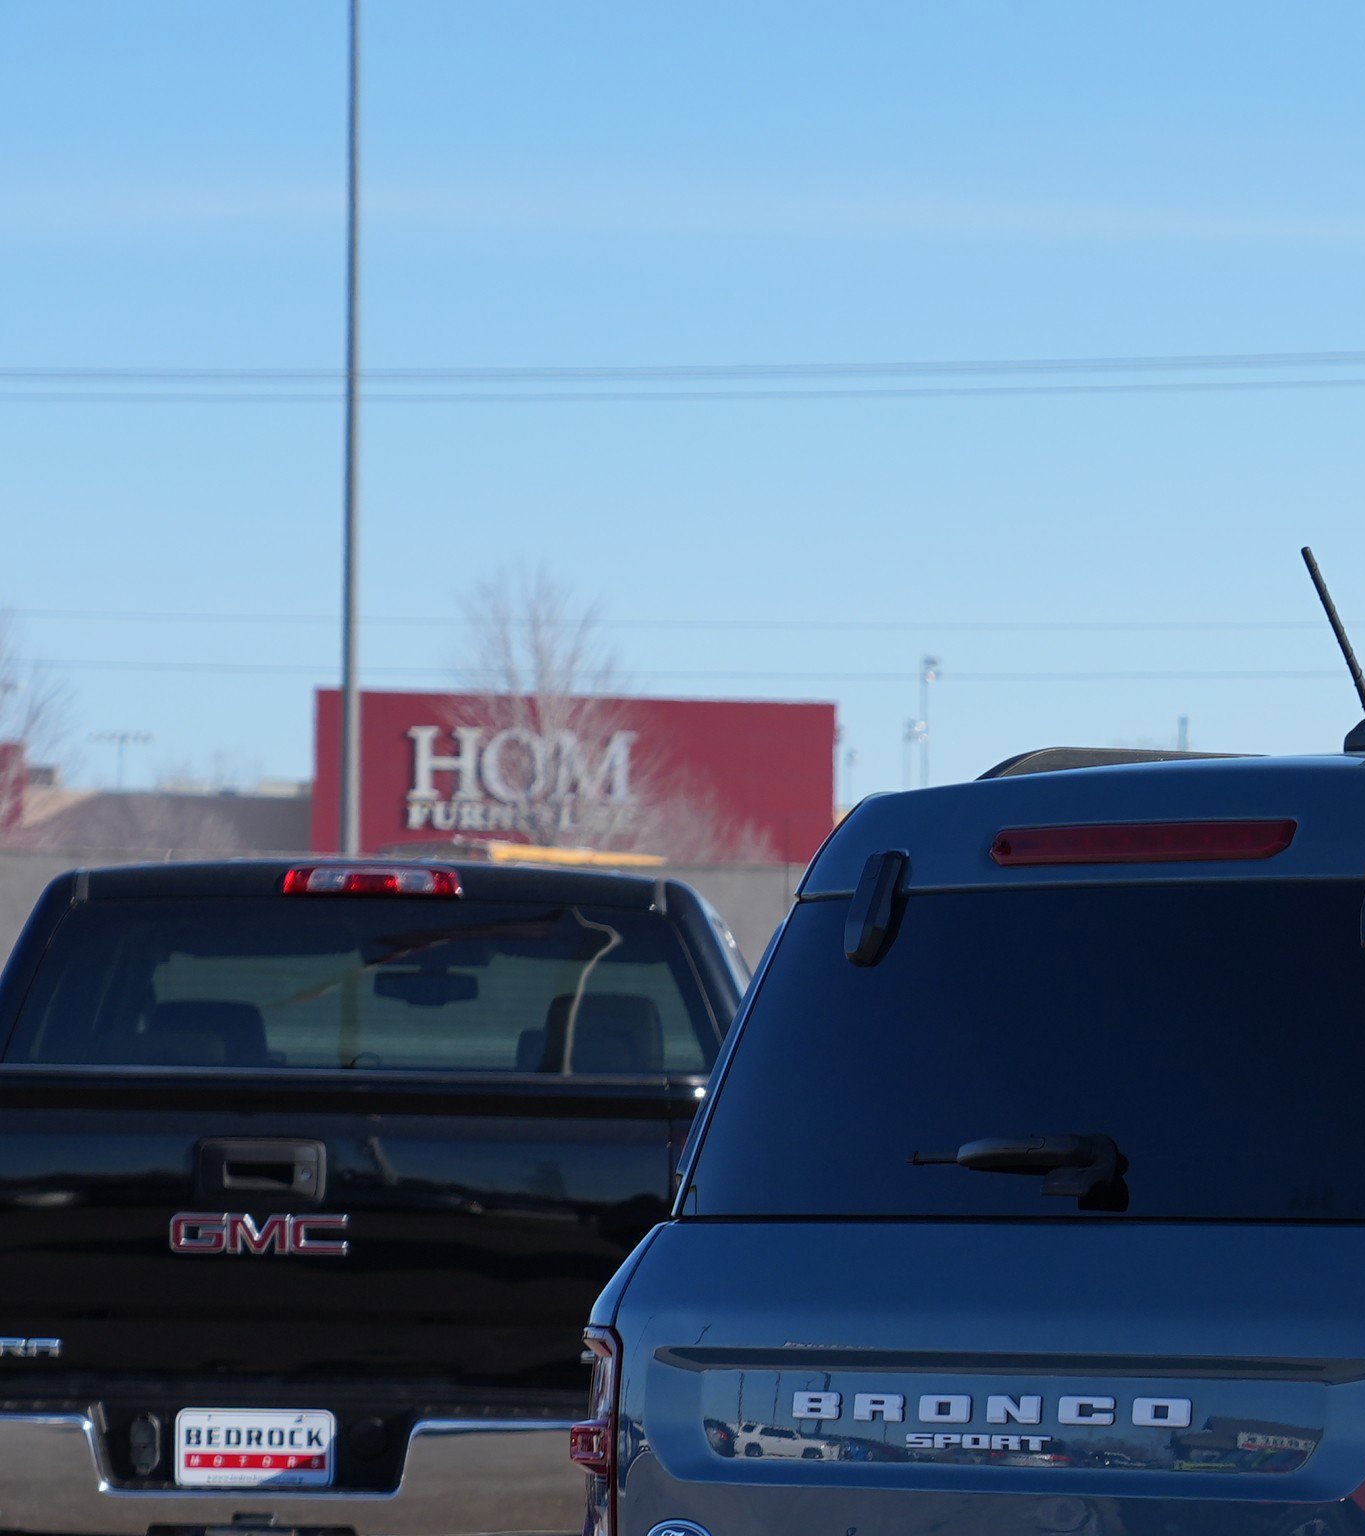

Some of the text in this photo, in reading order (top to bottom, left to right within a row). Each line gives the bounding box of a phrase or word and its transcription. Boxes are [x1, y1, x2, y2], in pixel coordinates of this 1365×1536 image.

[406, 725, 638, 801] HOM
[170, 1211, 350, 1256] GMC
[791, 1390, 1192, 1428] BRONCO
[184, 1426, 325, 1449] BEDROCK
[905, 1432, 1053, 1452] SPORT
[189, 1454, 320, 1469] MOTORS
